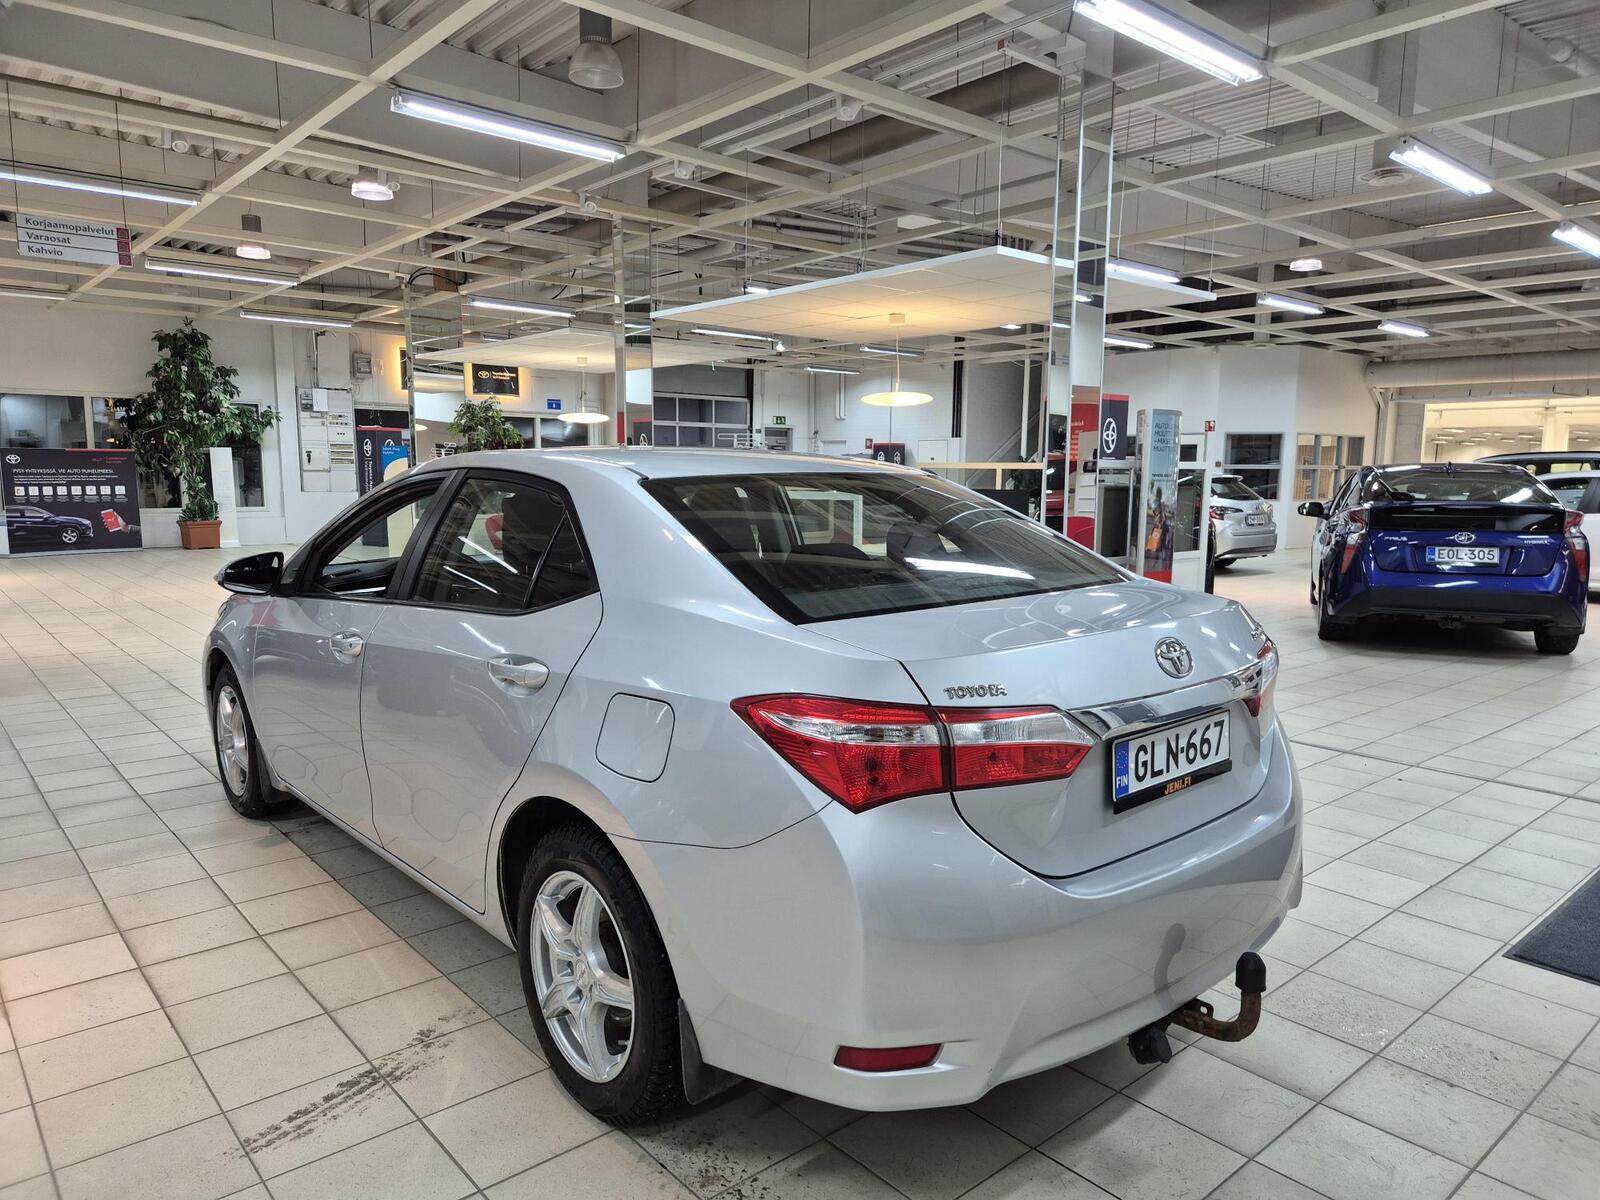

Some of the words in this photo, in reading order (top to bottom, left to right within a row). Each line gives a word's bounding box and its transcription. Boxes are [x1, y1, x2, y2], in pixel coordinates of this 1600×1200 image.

[25, 217, 115, 236] Korjaamopalvelut
[26, 231, 71, 245] Varaosat
[27, 245, 63, 257] Kahvio
[943, 684, 1008, 700] TOYOTA
[1134, 719, 1225, 783] GLN-667
[1116, 774, 1128, 789] FIN
[1164, 775, 1192, 795] JENI.FI
